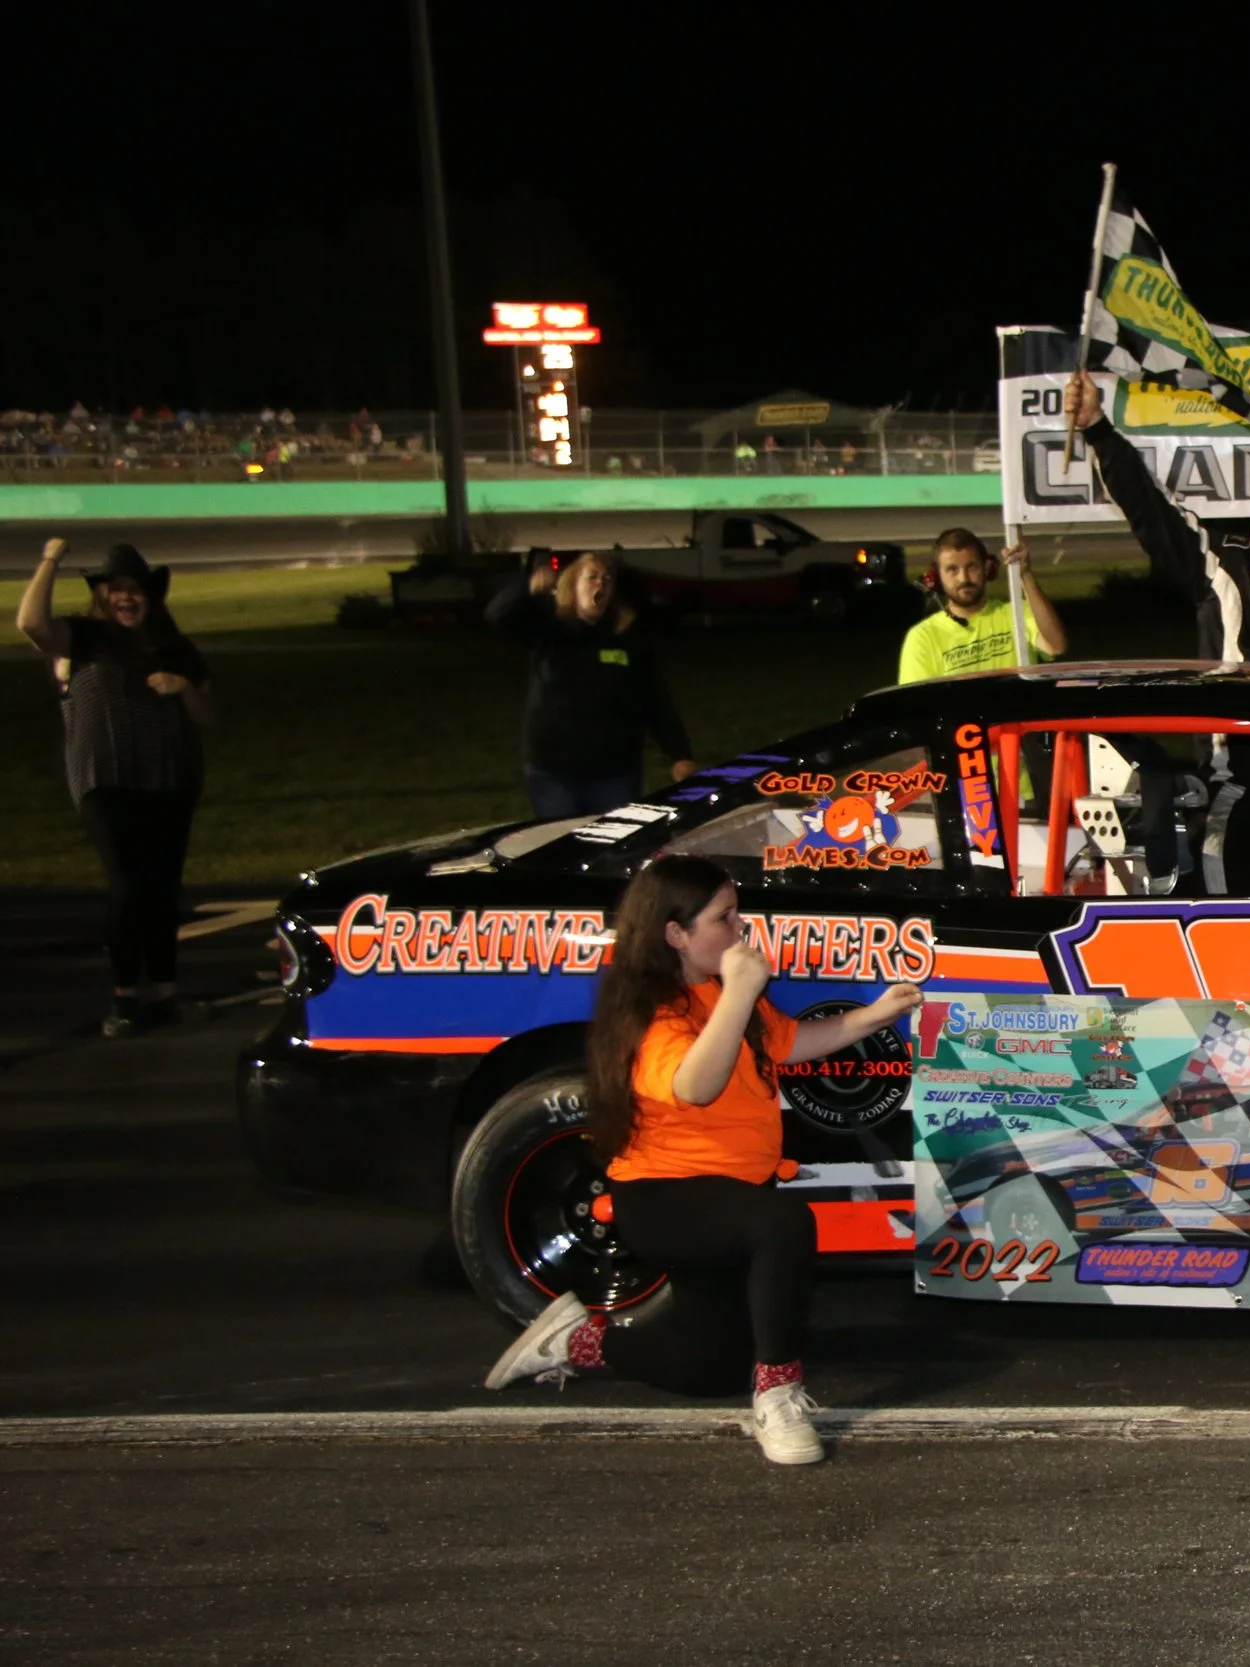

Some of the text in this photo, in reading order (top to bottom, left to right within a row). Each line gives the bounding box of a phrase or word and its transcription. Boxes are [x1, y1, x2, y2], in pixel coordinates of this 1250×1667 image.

[757, 769, 947, 795] GOLD CROWN
[954, 723, 999, 858] CHEVY
[336, 894, 934, 983] CREATIVE NTERS
[982, 1010, 1079, 1031] JOHNSBURY
[995, 1038, 1073, 1055] GMC
[917, 1064, 1073, 1088] CREATIVE COUNTERS
[791, 1087, 845, 1123] GRANITE
[857, 1088, 903, 1121] ZODIAQ
[923, 1090, 1005, 1104] SWITSER
[1010, 1093, 1062, 1106] SONS
[929, 1236, 1061, 1282] 2022
[1086, 1248, 1239, 1268] THUNDER ROAD
